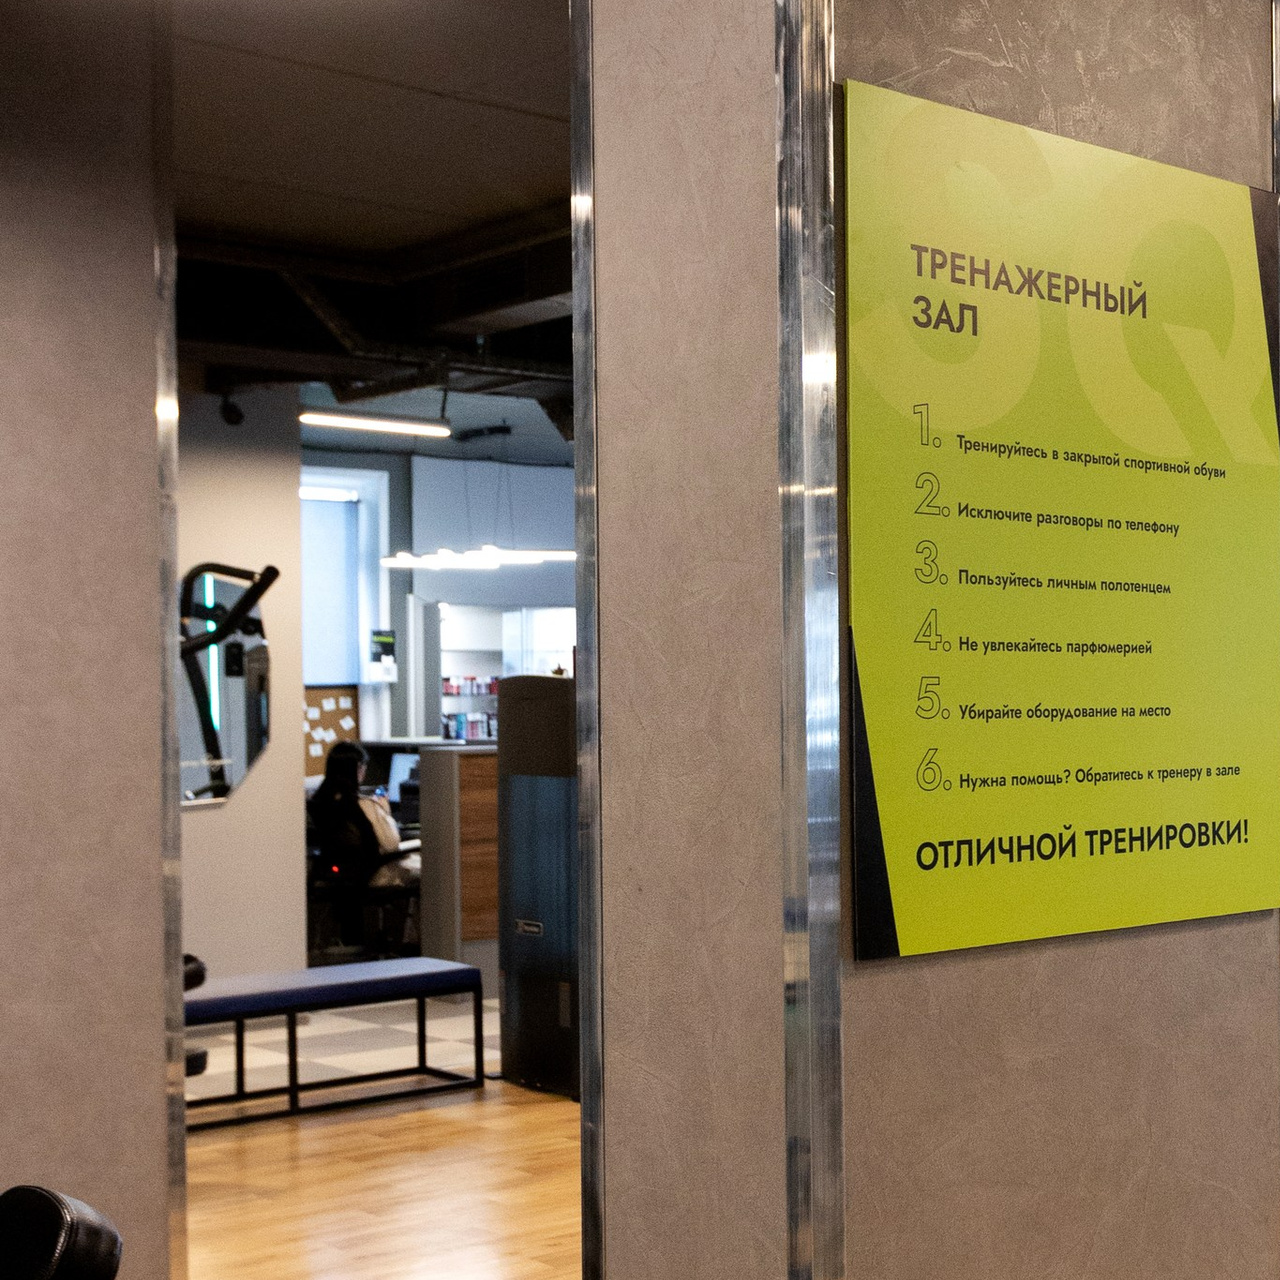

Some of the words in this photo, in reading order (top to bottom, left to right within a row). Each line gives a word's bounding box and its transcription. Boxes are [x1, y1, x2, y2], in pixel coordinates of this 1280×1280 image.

[911, 244, 1146, 320] ТРЕНАЖЕРНЫЙ
[912, 296, 978, 336] ЗАЛ
[913, 403, 941, 448] 1.
[956, 434, 1047, 459] Тренируйтесь
[1051, 449, 1060, 461] в
[1063, 451, 1120, 467] закрытой
[1124, 458, 1190, 474] спортивной
[1194, 462, 1225, 480] обуви
[914, 472, 950, 517] 2.
[958, 502, 1032, 522] Исключите
[1037, 513, 1103, 531] разговоры
[1108, 519, 1121, 529] по
[1125, 521, 1179, 537] телефону
[915, 540, 948, 585] 3.
[959, 569, 1043, 590] Пользуйтесь
[1047, 579, 1096, 590] личным
[1101, 581, 1171, 594] полотенцем
[914, 609, 951, 652] 4.
[959, 636, 978, 651] Не
[982, 638, 1062, 655] увлекайтесь
[1067, 641, 1152, 657] парфюмерией
[915, 676, 950, 719] 5.
[959, 703, 1022, 723] Убирайте
[1026, 702, 1117, 722] оборудование
[1122, 707, 1135, 717] на
[1139, 707, 1171, 716] место
[916, 748, 952, 791] 6.
[960, 773, 1006, 792] Нужна
[1011, 769, 1071, 786] помощь?
[1075, 767, 1143, 786] Обратитесь
[1147, 769, 1155, 780] к
[1157, 768, 1202, 782] тренеру
[1205, 767, 1213, 778] в
[1216, 766, 1240, 776] зале
[916, 824, 1076, 871] ОТЛИЧНОЙ
[1084, 819, 1248, 856] ТРЕНИРОВКИ!
